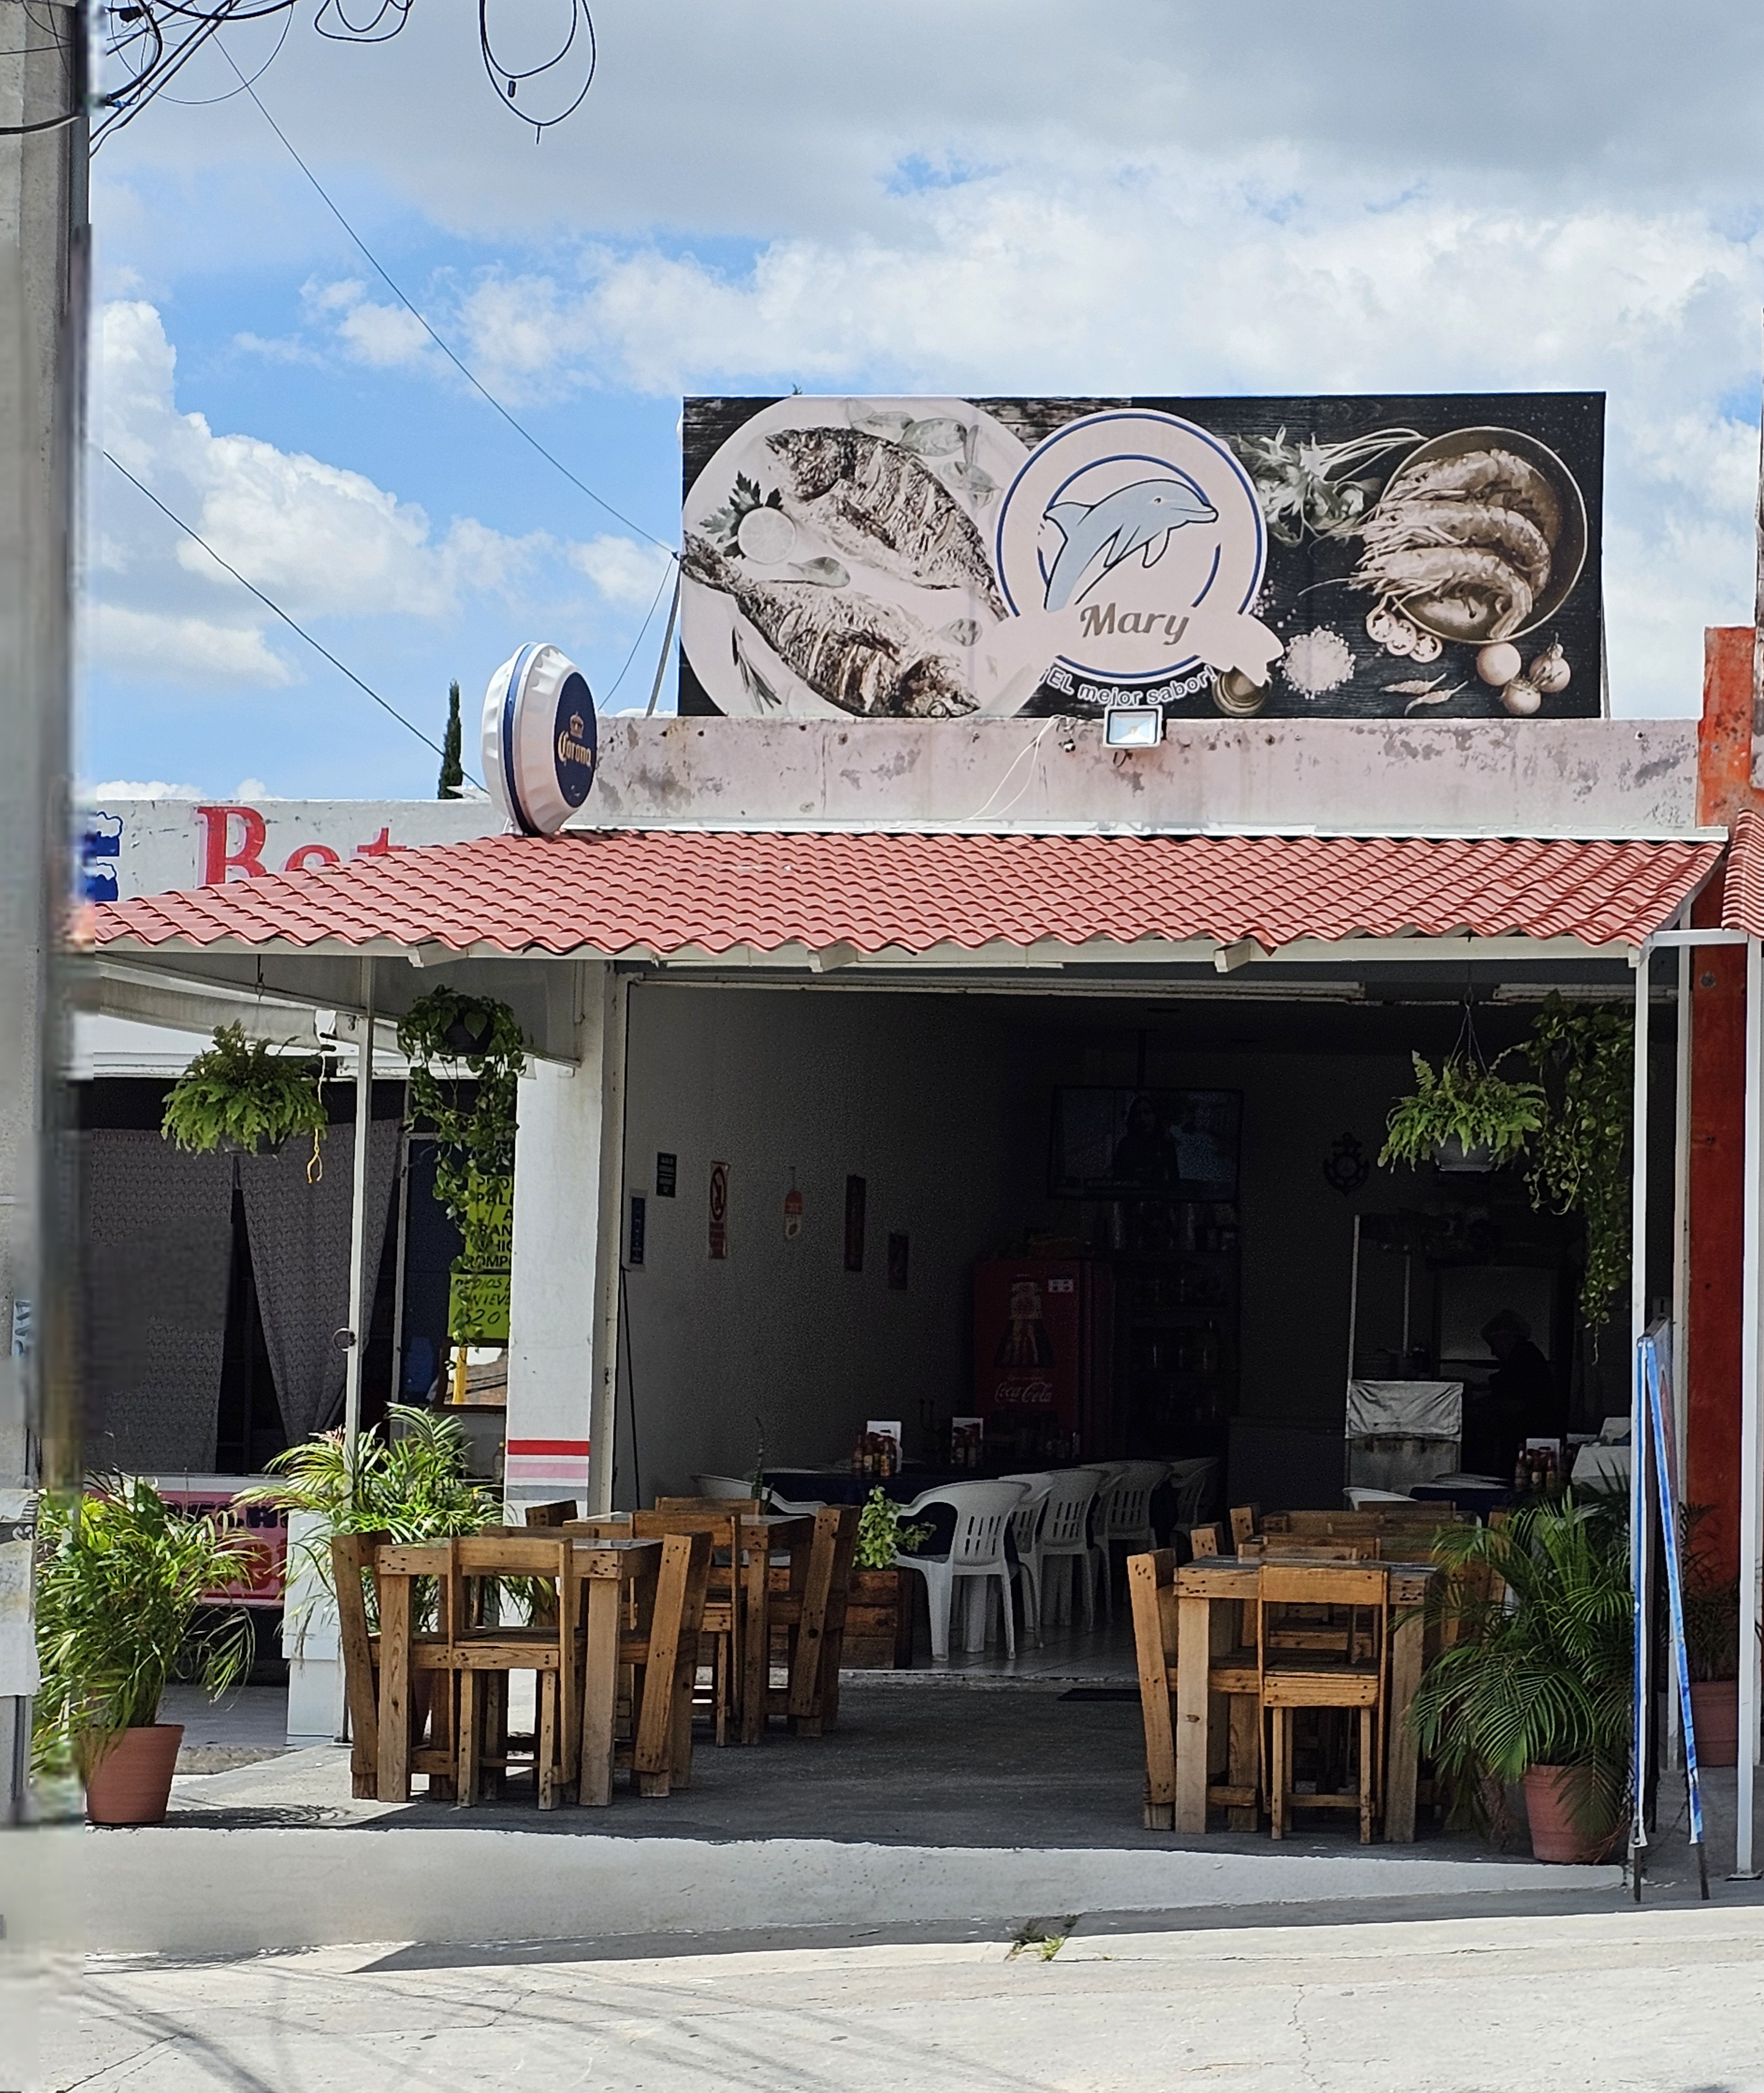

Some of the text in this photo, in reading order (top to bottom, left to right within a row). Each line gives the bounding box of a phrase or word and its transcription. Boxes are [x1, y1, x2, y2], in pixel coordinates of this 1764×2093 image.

[1080, 602, 1190, 645] Mary
[1077, 684, 1142, 706] mejor
[1146, 665, 1218, 704] sabor!
[558, 730, 592, 770] Corona
